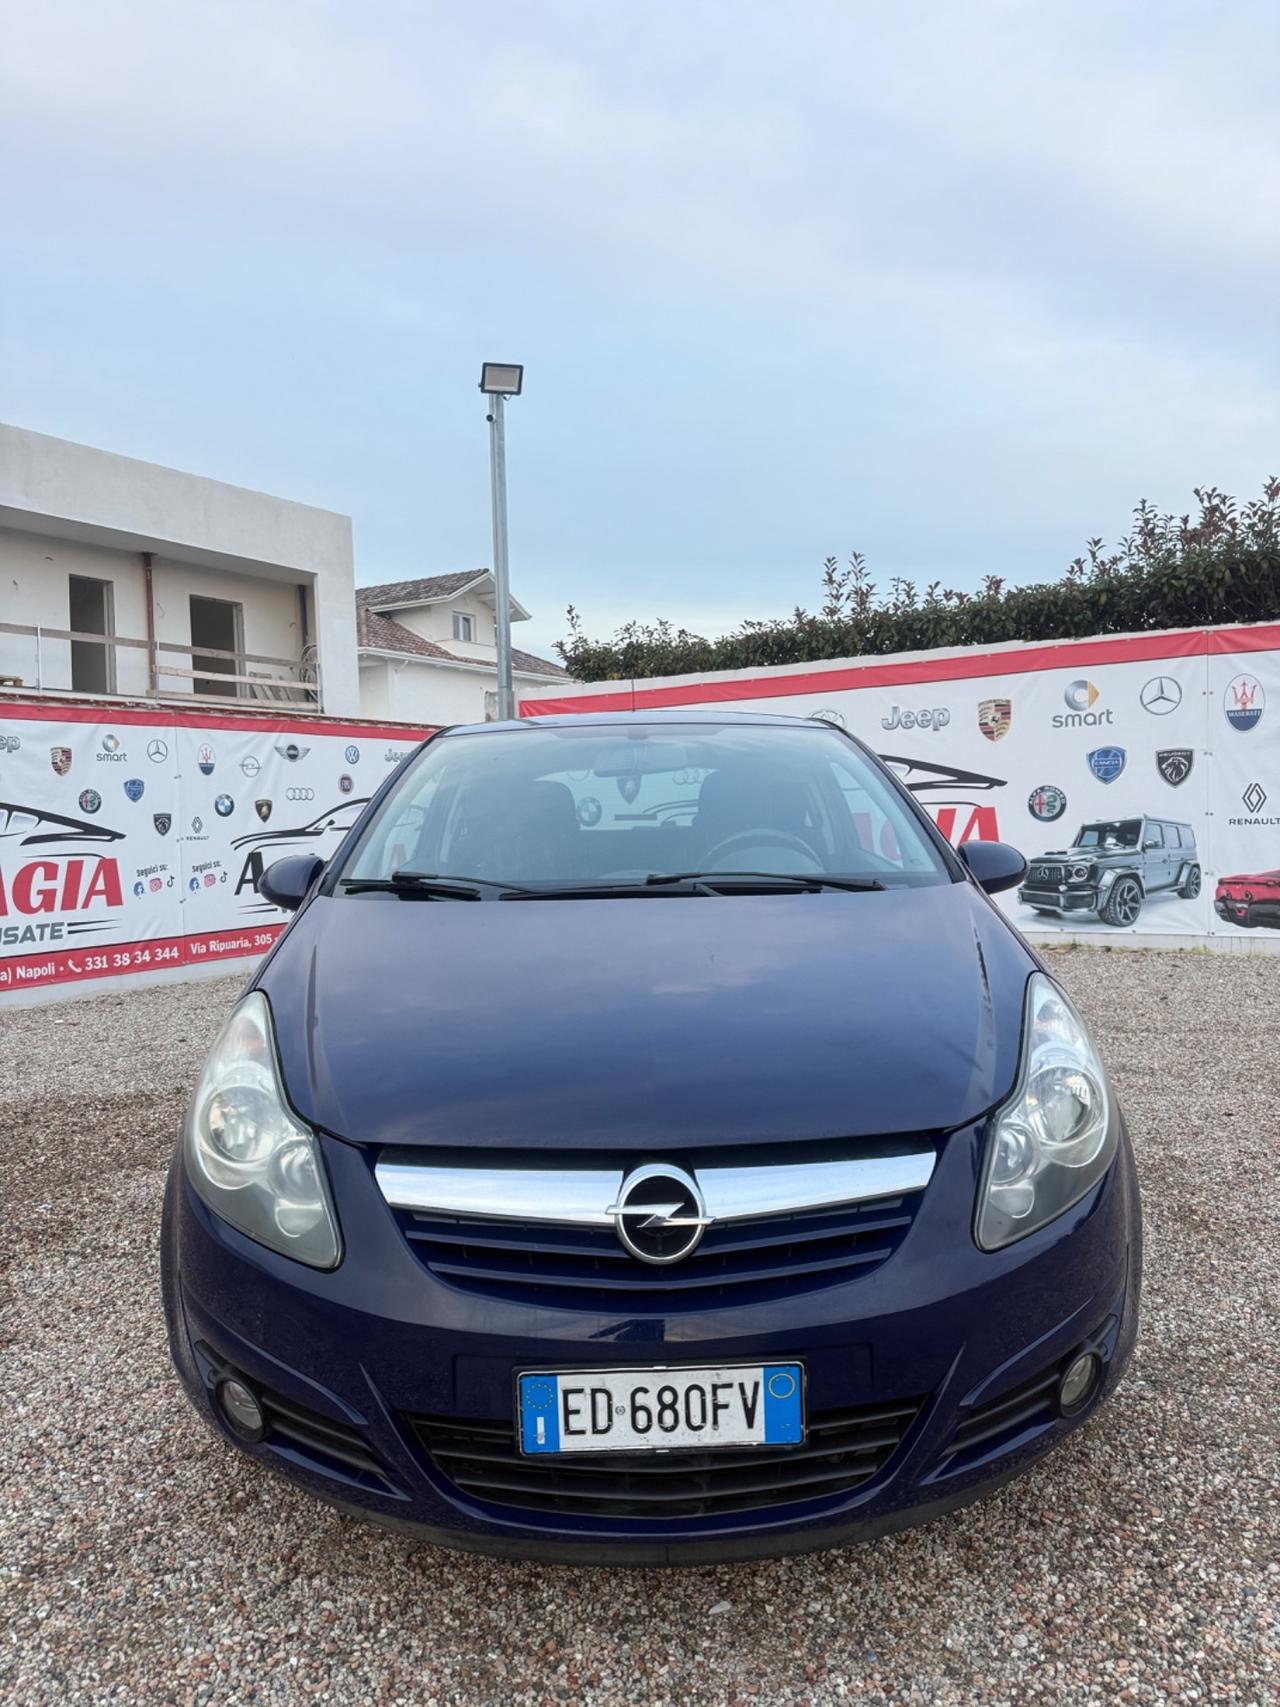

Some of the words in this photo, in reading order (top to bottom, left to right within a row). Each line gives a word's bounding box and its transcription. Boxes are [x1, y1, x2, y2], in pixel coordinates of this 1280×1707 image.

[881, 705, 951, 732] Jeep
[1051, 708, 1114, 729] smart
[1228, 709, 1262, 718] MASERATI
[96, 751, 128, 763] smart
[1228, 817, 1280, 826] RENAULT
[0, 921, 65, 946] SATE
[190, 942, 207, 955] Via
[208, 936, 252, 953] Ripuaria,
[254, 933, 273, 946] 305
[16, 962, 56, 982] Napoli
[84, 955, 109, 971] 331
[113, 952, 131, 968] 38
[135, 949, 151, 964] 34
[154, 946, 180, 962] 344
